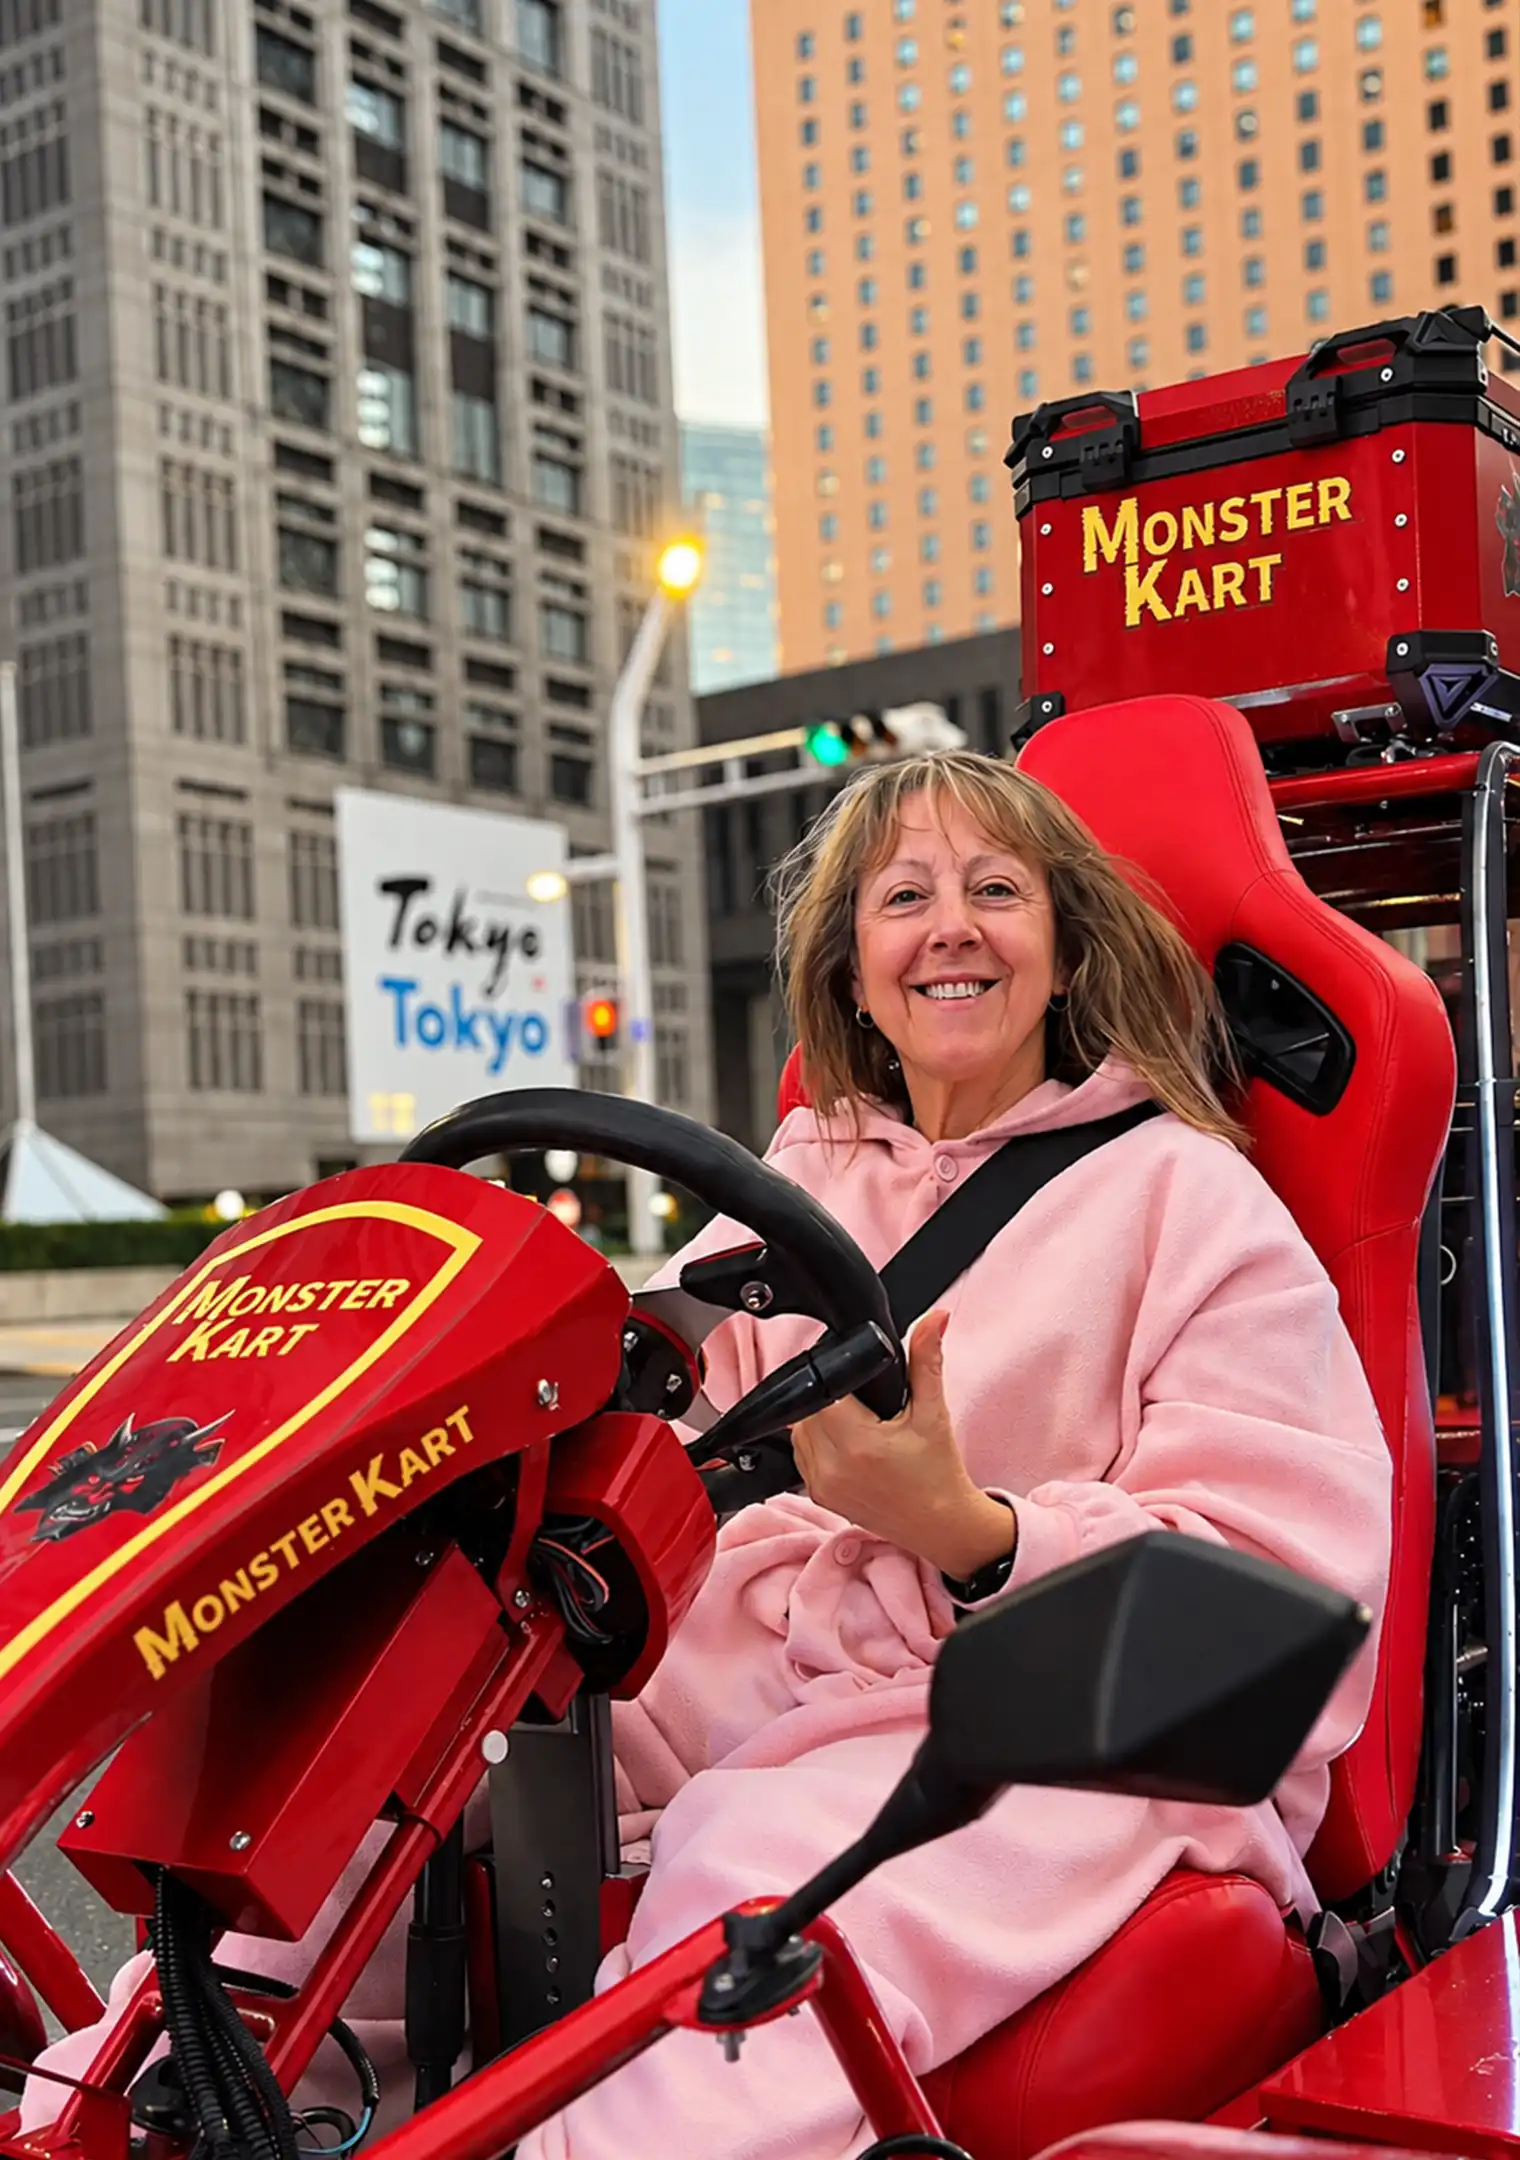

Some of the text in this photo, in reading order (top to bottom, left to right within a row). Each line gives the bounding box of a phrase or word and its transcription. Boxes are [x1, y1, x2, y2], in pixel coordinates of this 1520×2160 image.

[1082, 476, 1353, 574] MONSTER
[1124, 554, 1282, 627] KART
[378, 877, 541, 996] Tokyo
[378, 976, 548, 1075] Tokyo
[167, 1317, 319, 1363] KART
[173, 1275, 410, 1325] MONSTER
[133, 1405, 475, 1681] MONSTER KART
